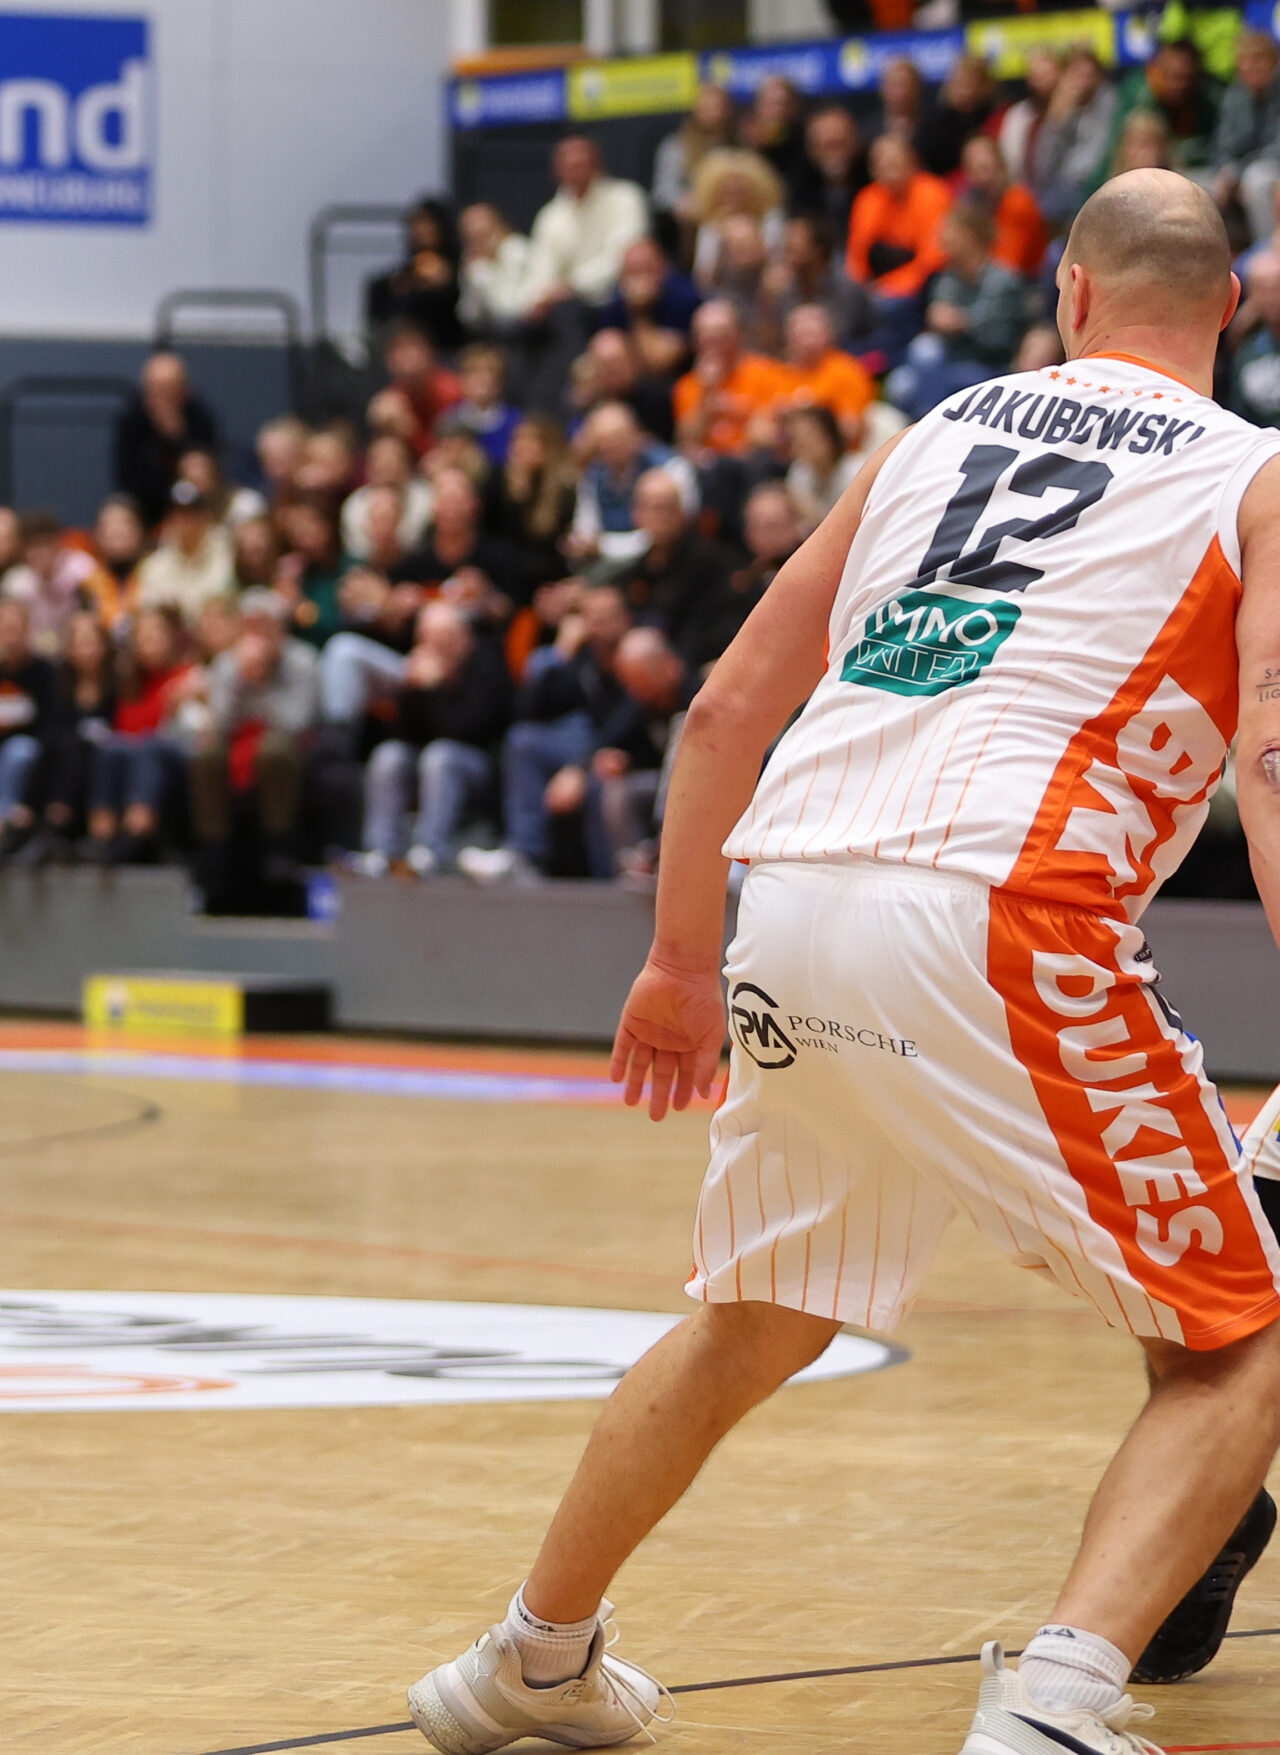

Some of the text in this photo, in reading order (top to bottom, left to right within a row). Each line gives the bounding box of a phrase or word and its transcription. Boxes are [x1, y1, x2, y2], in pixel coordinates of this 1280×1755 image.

[904, 444, 1115, 592] 12
[875, 600, 998, 646] IMMO
[787, 1015, 919, 1058] PORSCHE
[794, 1037, 839, 1054] WIEN
[1031, 950, 1225, 1268] DUKES
